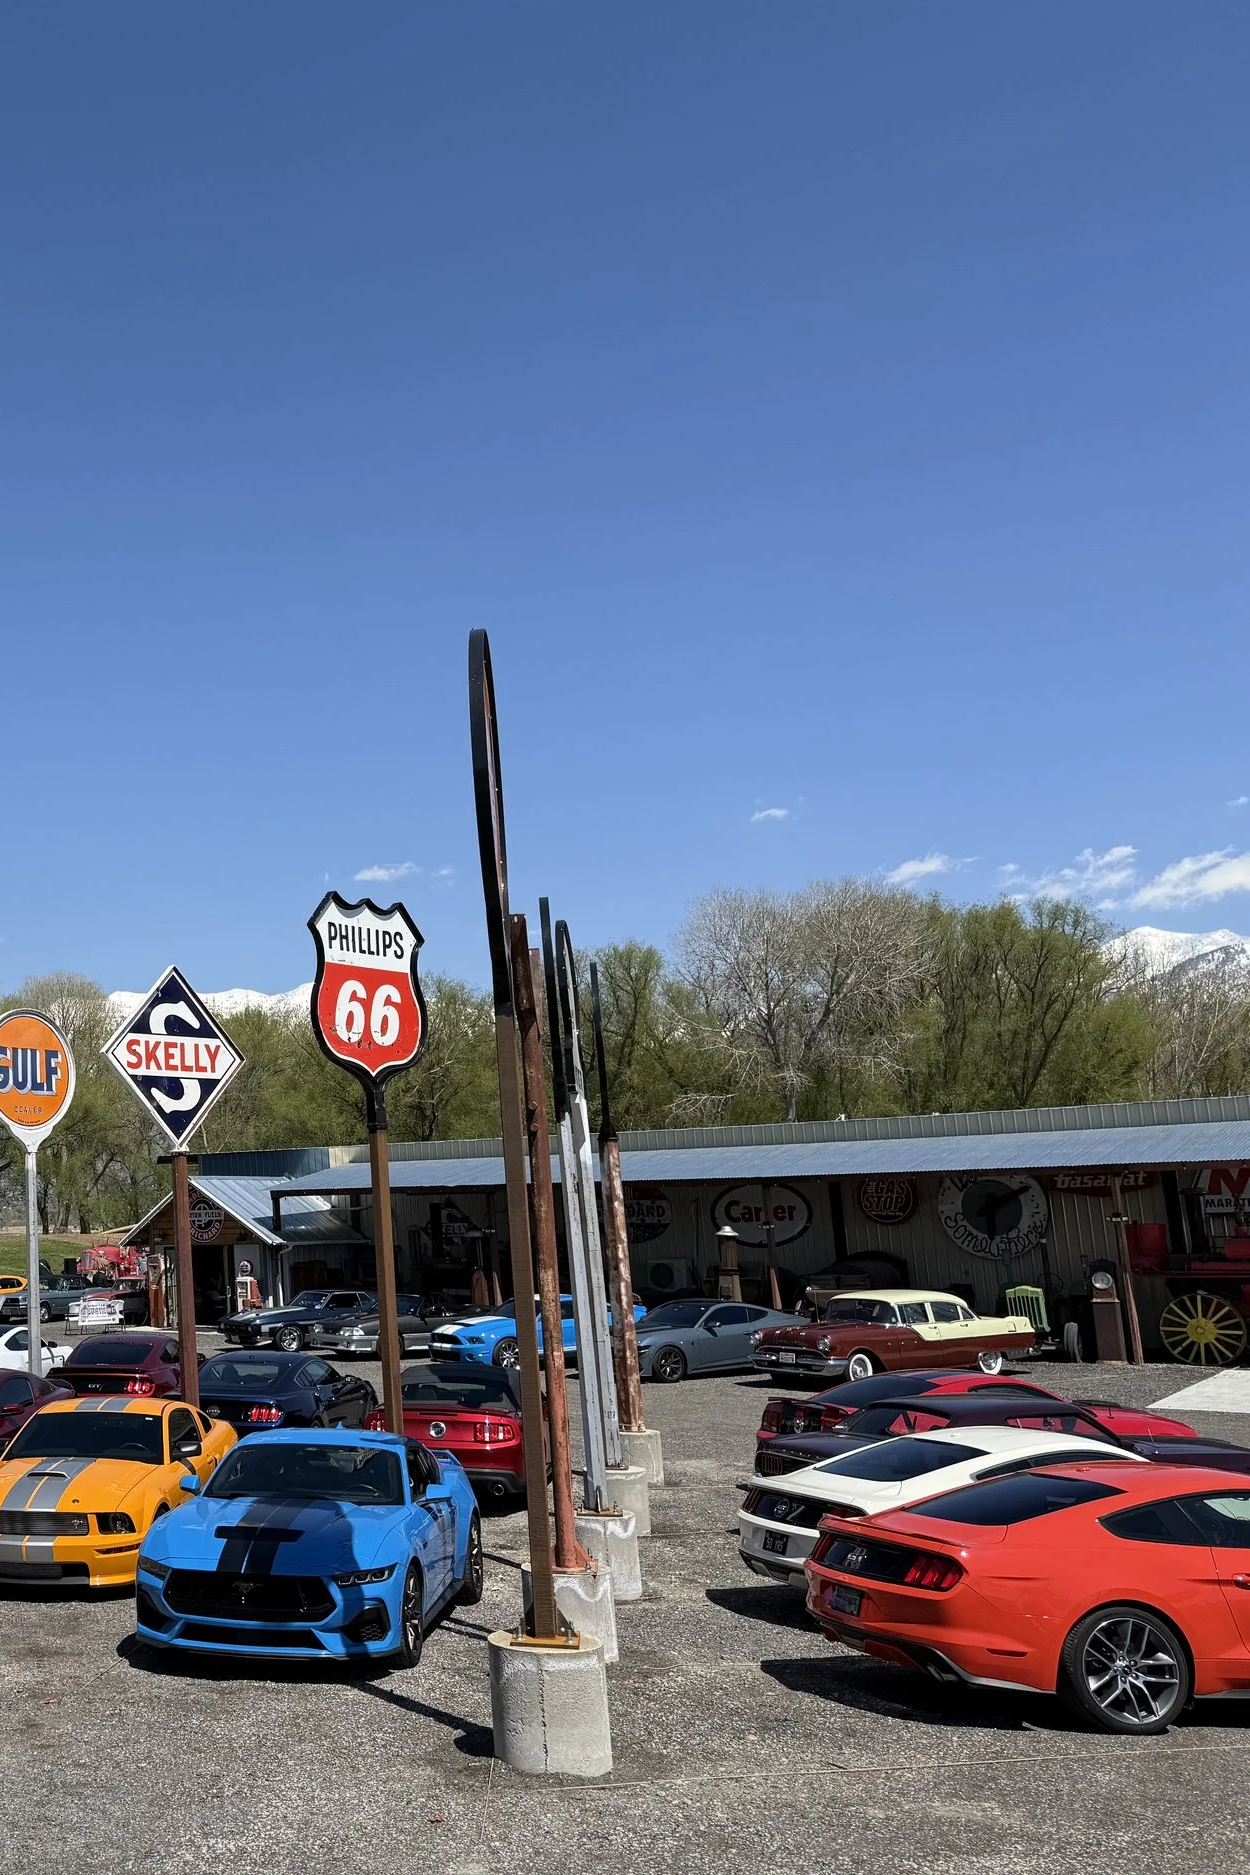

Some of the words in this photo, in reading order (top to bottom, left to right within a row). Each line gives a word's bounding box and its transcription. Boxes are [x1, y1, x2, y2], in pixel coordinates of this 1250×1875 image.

[327, 921, 405, 960] PHILLIPS
[334, 979, 402, 1047] 66
[125, 1038, 221, 1073] SKELLY
[875, 1178, 907, 1195] GAS
[724, 1200, 797, 1223] Carer
[864, 1193, 906, 1211] STOP
[190, 1222, 220, 1240] RICHARD
